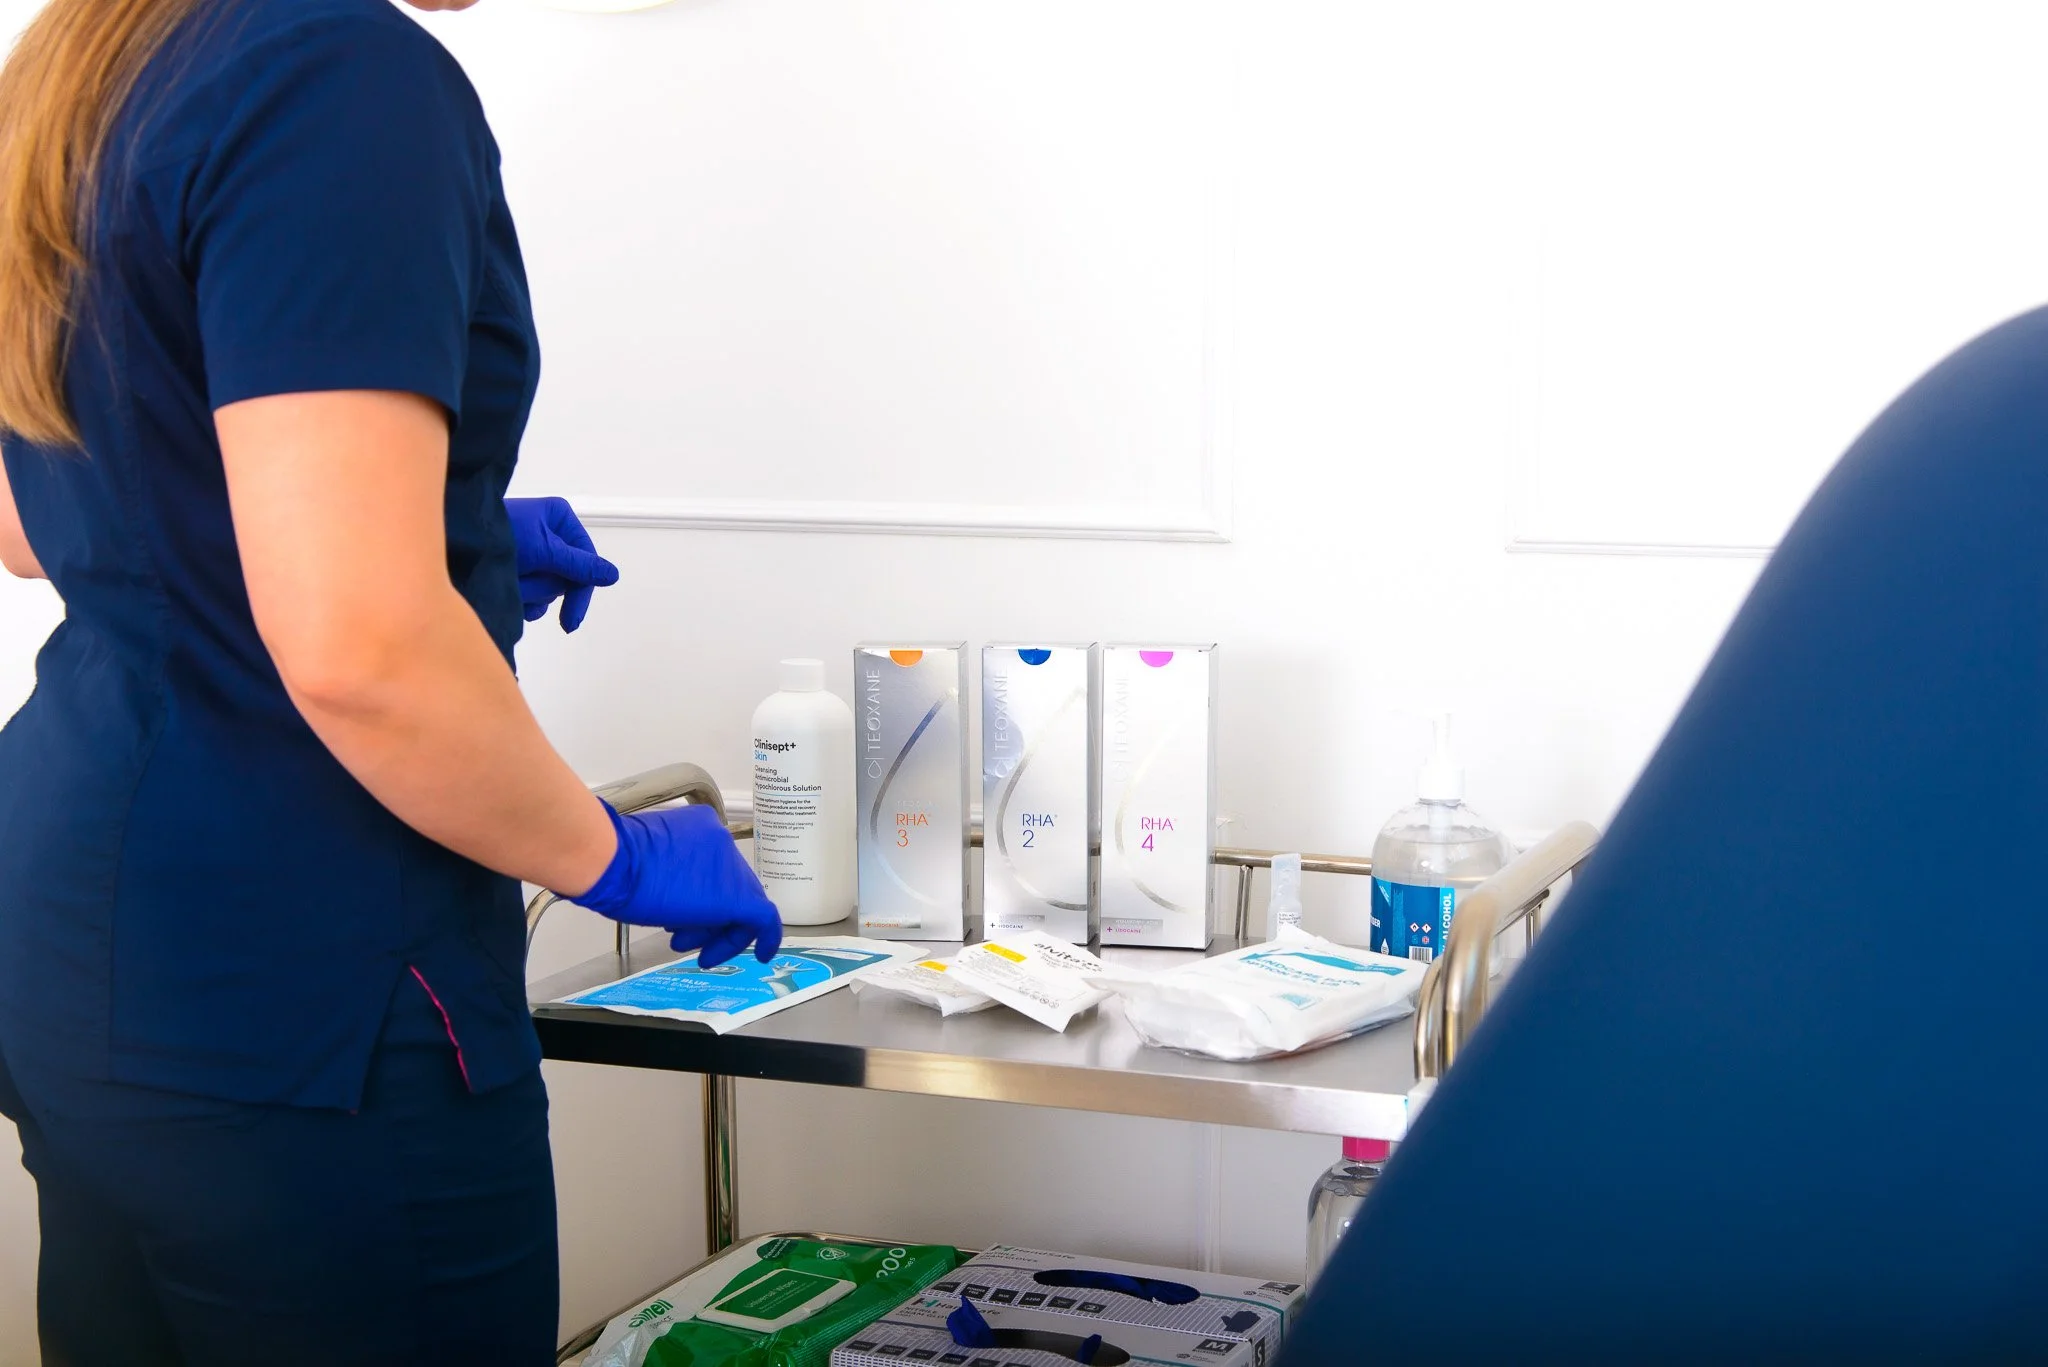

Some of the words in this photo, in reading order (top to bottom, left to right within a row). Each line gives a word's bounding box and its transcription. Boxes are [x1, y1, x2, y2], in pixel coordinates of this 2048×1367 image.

[866, 669, 881, 753] TEOXANE
[993, 664, 1009, 752] TEOXANE
[754, 738, 797, 754] Clinisept+
[754, 750, 768, 761] Skin
[755, 764, 778, 776] Cleansing
[755, 773, 789, 783] Antimicrobial
[792, 784, 822, 792] Solution
[897, 829, 909, 848] 3
[1022, 829, 1034, 848] 2
[1141, 833, 1154, 852] 4
[628, 1298, 674, 1329] clinell
[1205, 1341, 1227, 1351] M
